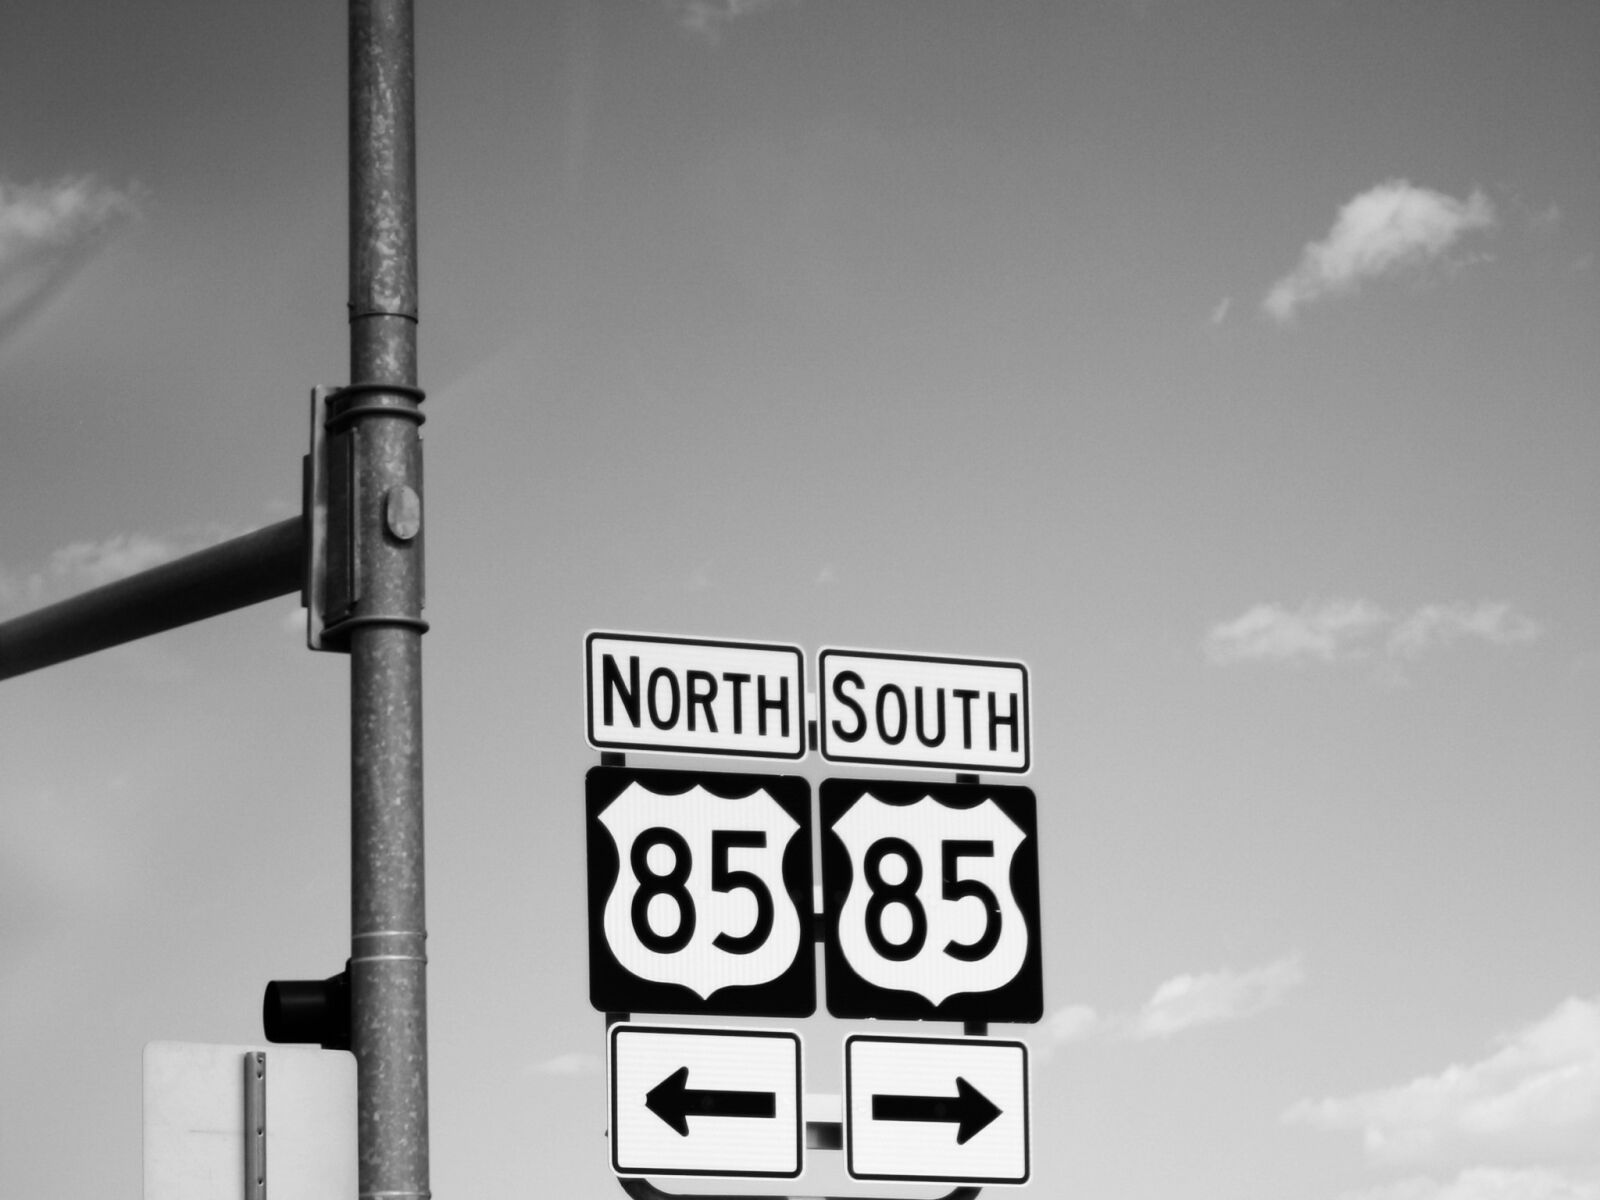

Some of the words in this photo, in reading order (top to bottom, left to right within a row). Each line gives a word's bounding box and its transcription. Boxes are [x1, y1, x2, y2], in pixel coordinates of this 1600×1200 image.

[601, 653, 790, 738] NORTH
[831, 669, 1020, 753] SOUTH
[630, 826, 775, 955] 85
[863, 836, 1003, 962] 85
